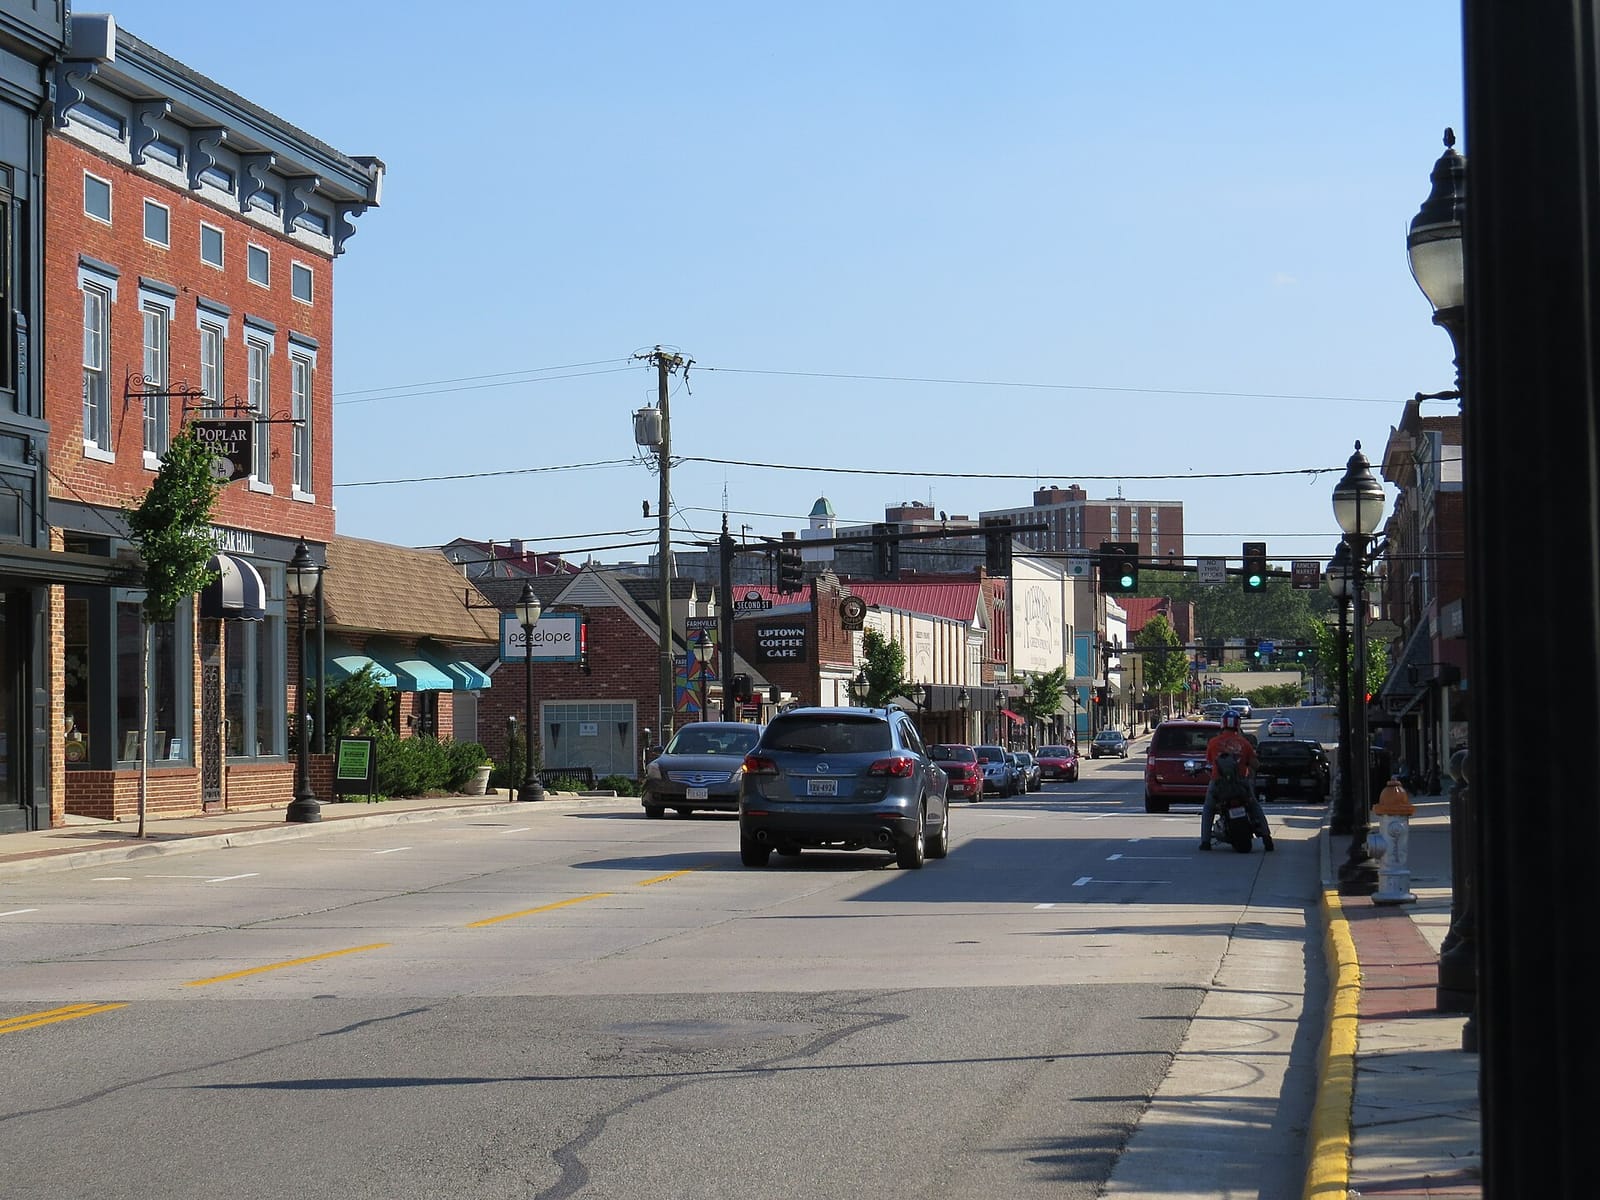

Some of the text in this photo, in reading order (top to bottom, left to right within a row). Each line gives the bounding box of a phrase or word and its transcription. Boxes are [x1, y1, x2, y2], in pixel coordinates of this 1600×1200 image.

[196, 427, 247, 441] POPLAR
[205, 442, 240, 454] HALL
[236, 531, 255, 554] HALL
[736, 601, 769, 609] SECOND ST
[687, 619, 717, 628] FARMVILLE
[757, 628, 805, 637] UPTOWN
[760, 638, 803, 647] COFFEE
[766, 649, 797, 657] CAFE
